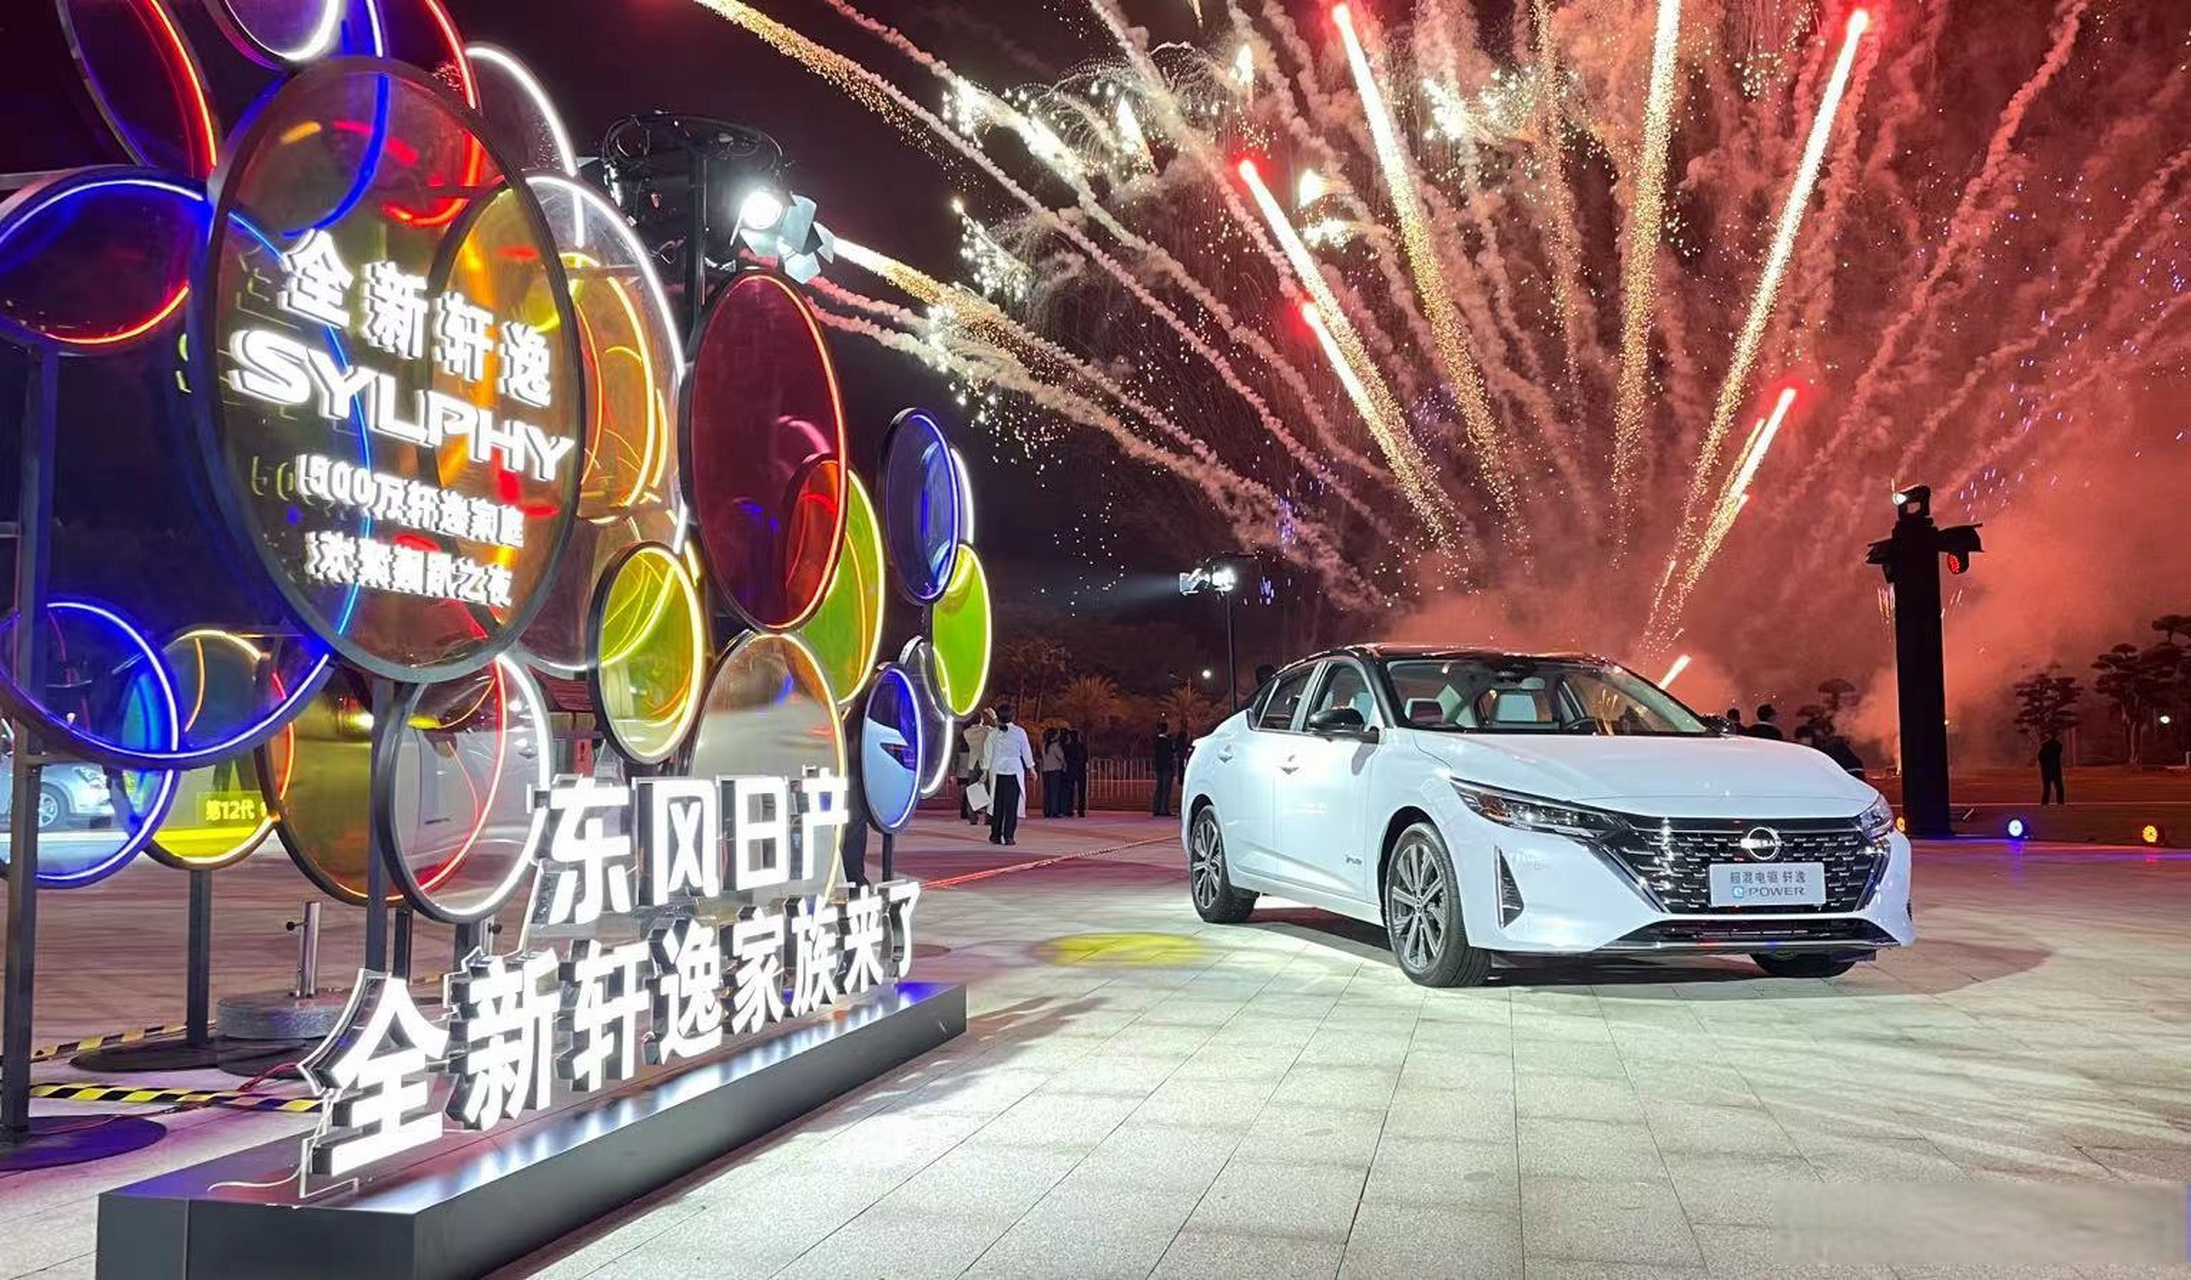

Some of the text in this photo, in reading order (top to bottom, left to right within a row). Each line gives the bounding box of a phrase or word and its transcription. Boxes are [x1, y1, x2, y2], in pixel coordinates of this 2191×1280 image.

[278, 229, 552, 407] 全新轩逸
[229, 330, 574, 482] SYLPHY
[542, 765, 849, 925] 东风日产
[1782, 871, 1806, 884] 轩逸
[310, 881, 920, 1177] 全新轩逸家族来了
